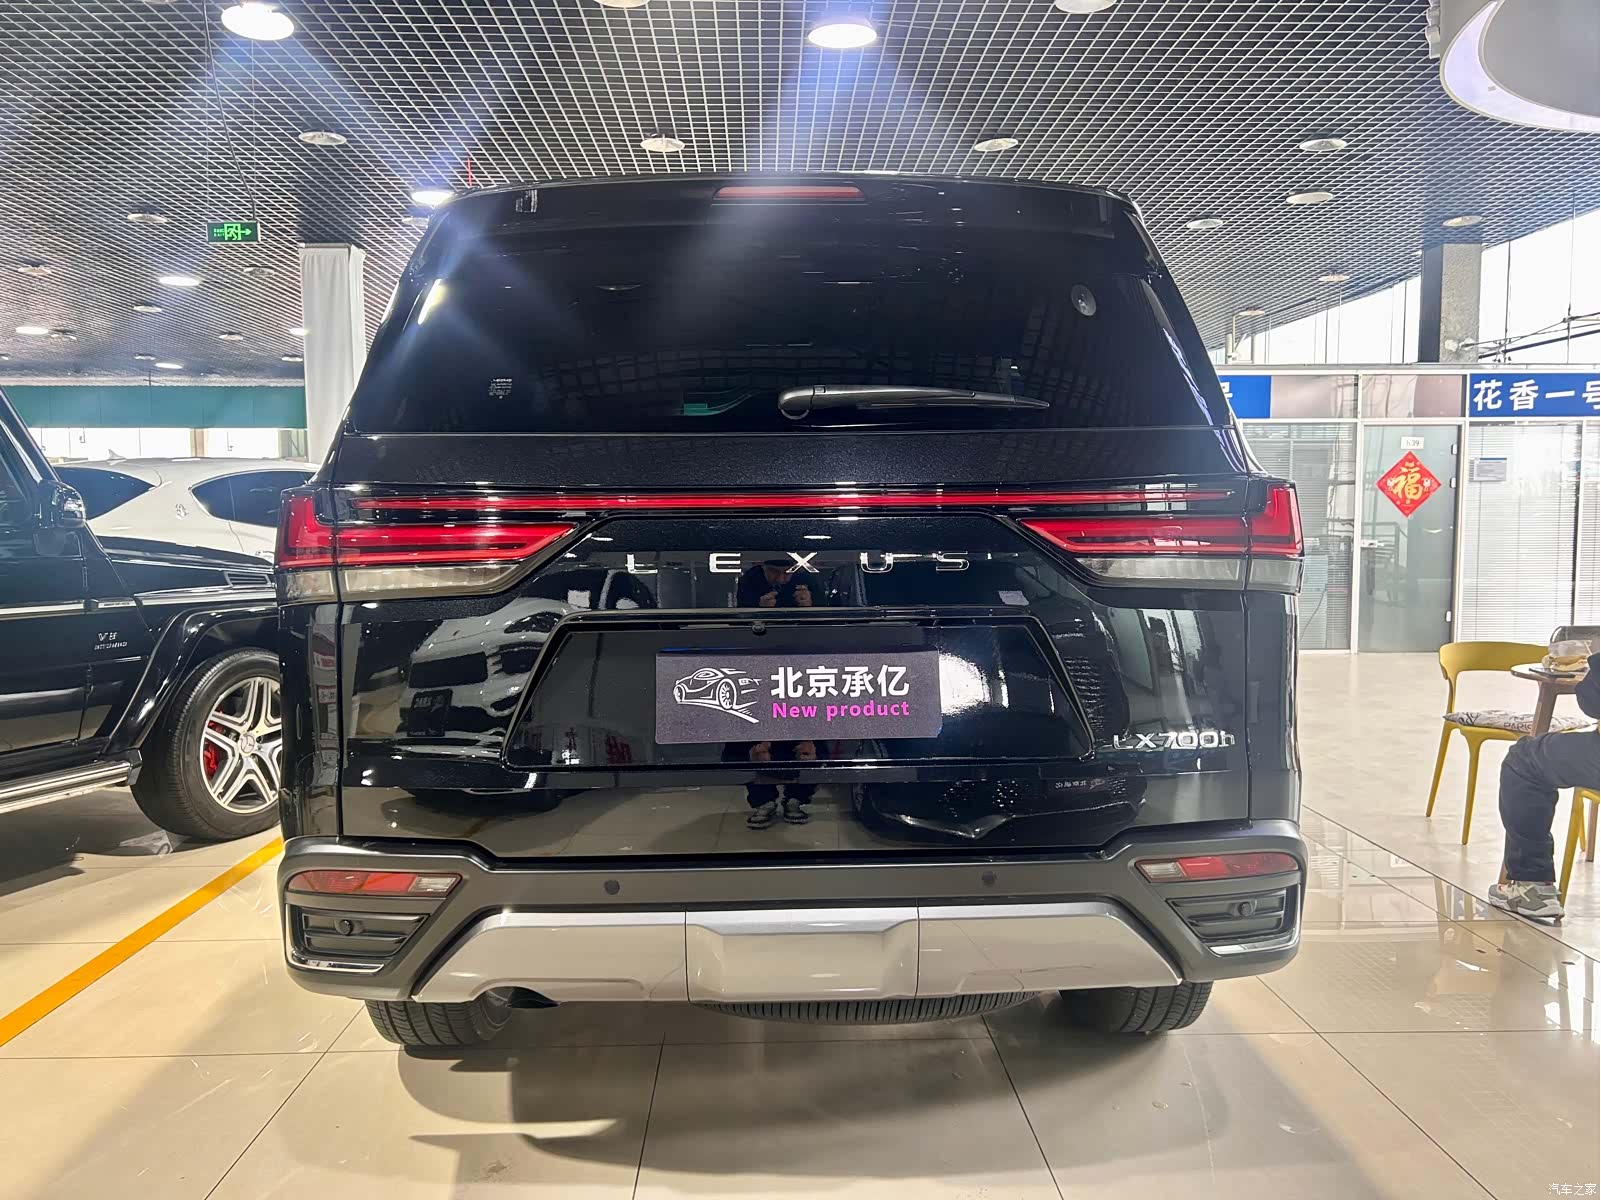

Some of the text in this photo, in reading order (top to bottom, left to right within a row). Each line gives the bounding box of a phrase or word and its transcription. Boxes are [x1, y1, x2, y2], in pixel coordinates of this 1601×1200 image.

[1473, 379, 1600, 411] 花香一号
[1392, 466, 1424, 500] 福
[626, 551, 970, 574] LEXUS
[770, 664, 910, 699] 北京承亿
[772, 700, 910, 722] New product
